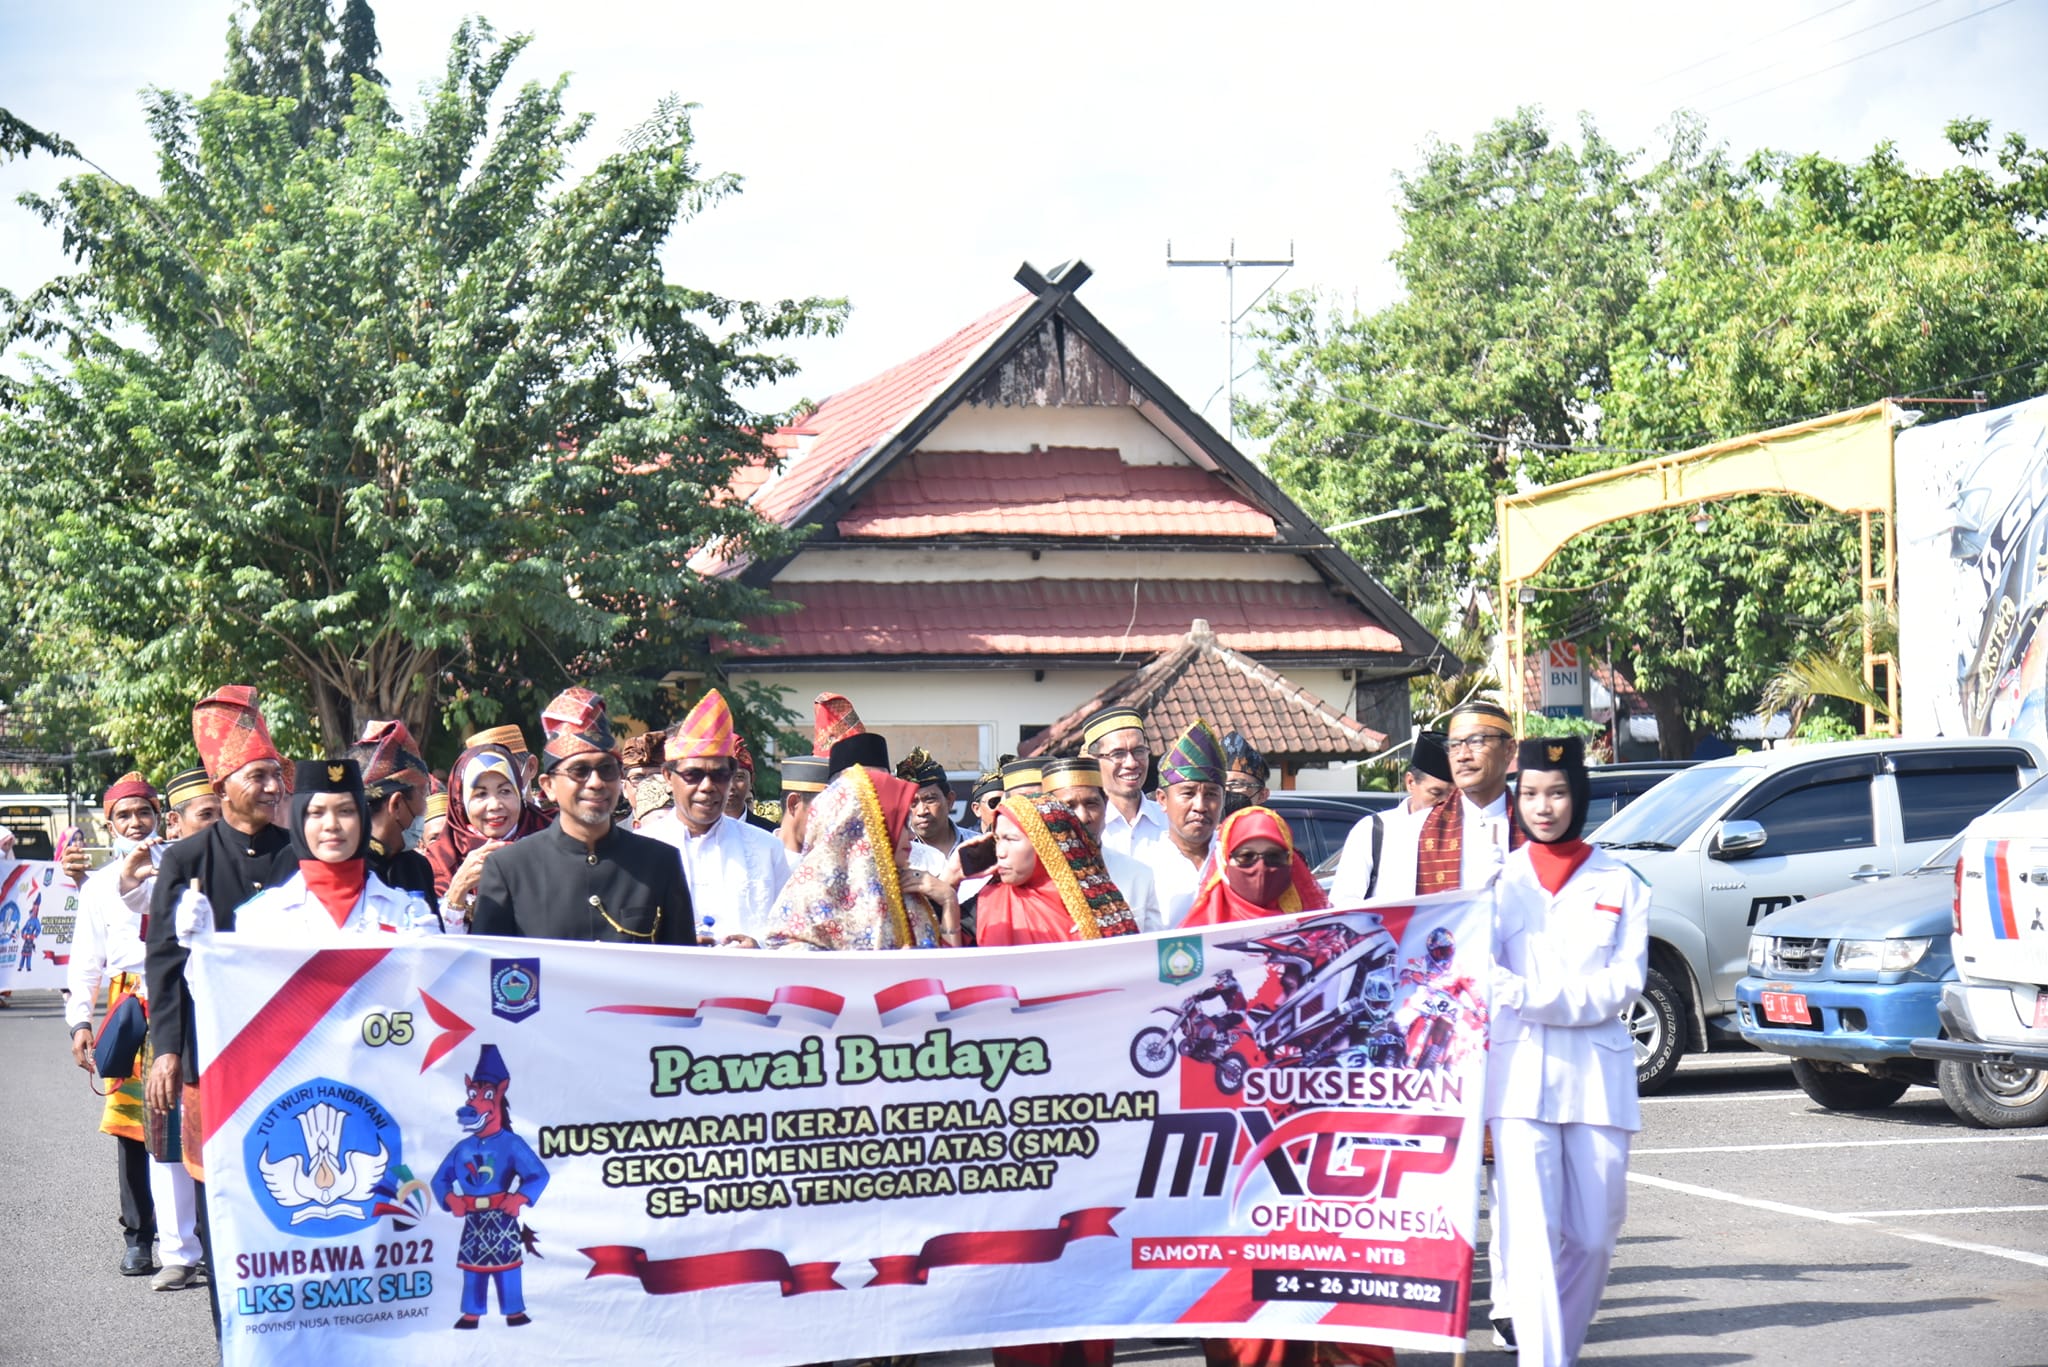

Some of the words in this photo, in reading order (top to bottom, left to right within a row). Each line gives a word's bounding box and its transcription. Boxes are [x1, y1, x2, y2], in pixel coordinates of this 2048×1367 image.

[1551, 671, 1578, 686] BNI
[1549, 707, 1568, 716] ATM
[1710, 881, 1747, 892] HILUX
[362, 1012, 414, 1047] 05
[1639, 989, 1676, 1083] BRIDGESTO
[650, 1035, 827, 1098] Pawai
[836, 1028, 1051, 1092] Budaya
[1246, 1071, 1464, 1105] SUKSESKAN
[257, 1108, 280, 1135] TUT
[278, 1087, 314, 1111] WURI
[317, 1086, 388, 1130] HANDAYANI
[539, 1112, 767, 1159] MUSYAWARAH
[772, 1106, 879, 1141] KERJA
[882, 1099, 1007, 1135] KEPALA
[1009, 1090, 1158, 1126] SEKOLAH
[602, 1148, 748, 1187] SEKOLAH
[752, 1136, 925, 1177] MENENGAH
[928, 1131, 1007, 1164] ATAS
[1008, 1125, 1100, 1163] (SMA)
[1135, 1109, 1465, 1200] MXGP
[646, 1185, 702, 1219] SE-
[705, 1180, 792, 1215] NUSA
[792, 1166, 957, 1206] TENGGARA
[959, 1160, 1059, 1195] BARAT
[1252, 1205, 1292, 1227] OF
[1301, 1206, 1450, 1236] INDONESIA
[236, 1245, 365, 1280] SUMBAWA
[374, 1238, 434, 1269] 2022
[1139, 1244, 1223, 1261] SAMOTA
[1243, 1244, 1347, 1263] SUMBAWA
[1366, 1247, 1406, 1265] NTB
[237, 1283, 295, 1315] LKS
[302, 1276, 374, 1310] SMK
[379, 1271, 433, 1303] SLB
[1276, 1277, 1300, 1293] 24
[1320, 1278, 1344, 1294] 26
[1347, 1278, 1399, 1297] JUNI
[1402, 1283, 1442, 1302] 2022
[245, 1322, 296, 1335] PROVINSI
[300, 1317, 330, 1329] NUSA
[333, 1311, 394, 1326] TENGGARA
[397, 1307, 429, 1320] BARAT
